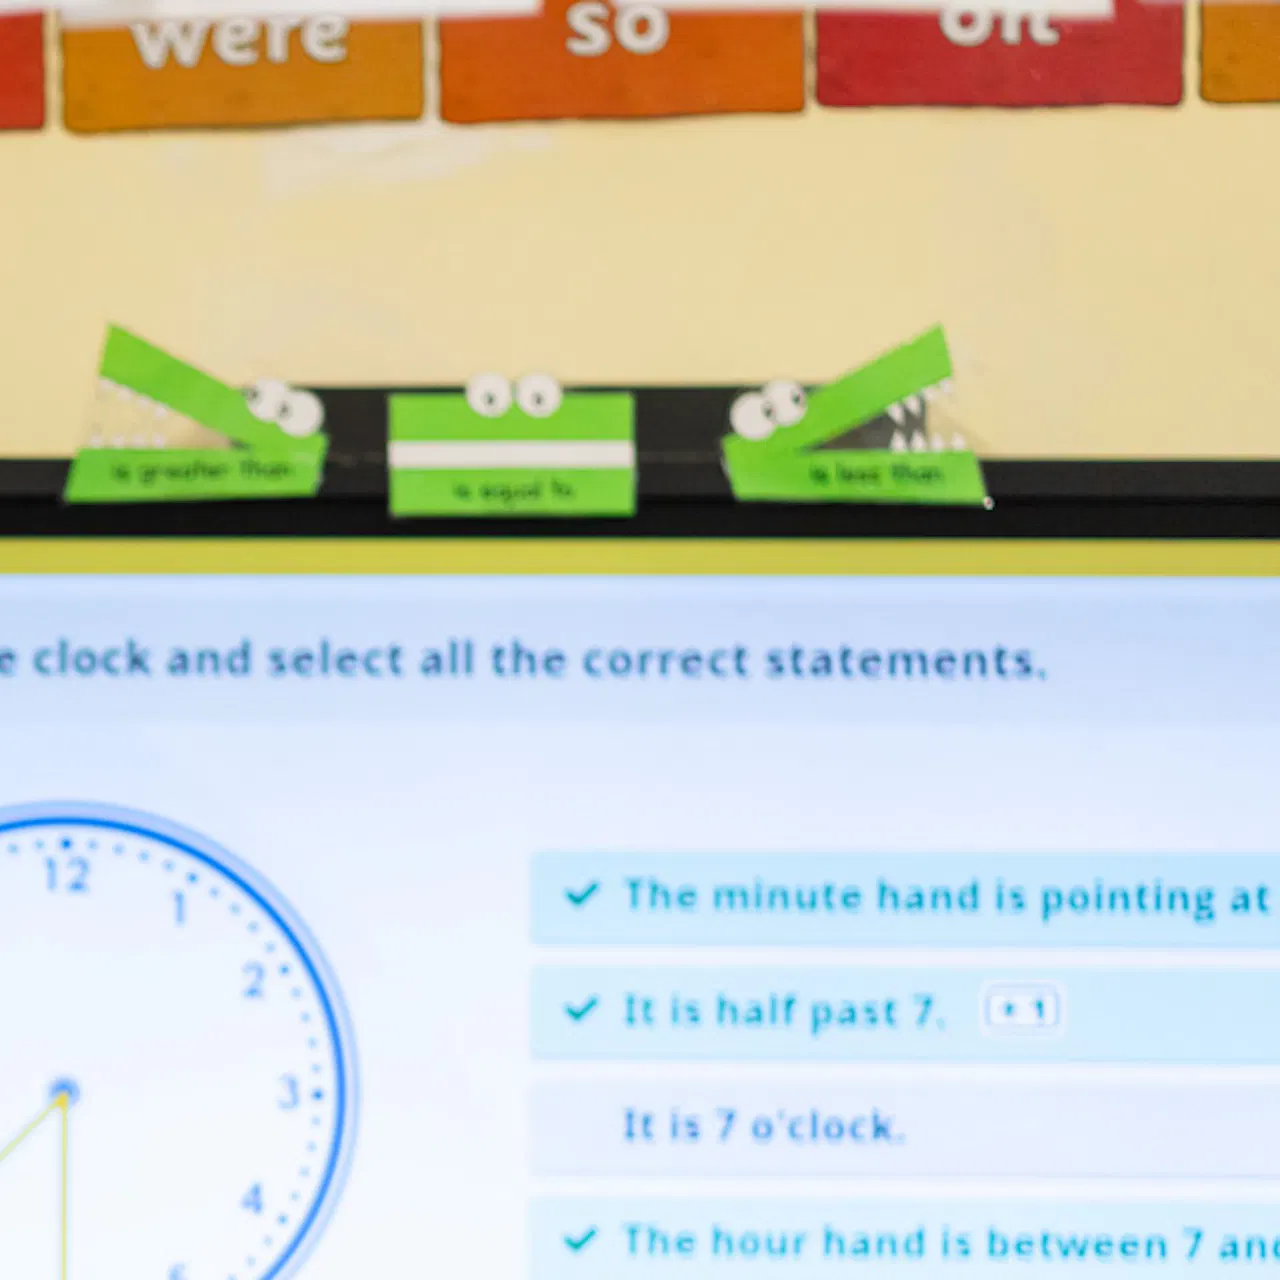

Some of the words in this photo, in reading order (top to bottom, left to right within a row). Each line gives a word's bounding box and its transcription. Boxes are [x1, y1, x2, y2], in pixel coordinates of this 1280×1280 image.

[130, 12, 350, 69] were
[564, 2, 670, 56] so
[32, 637, 151, 677] clock
[166, 638, 252, 677] and
[267, 639, 402, 677] select
[419, 639, 474, 677] all
[490, 639, 567, 677] the
[582, 645, 748, 678] correct
[766, 645, 1046, 679] statements.
[44, 855, 91, 894] 12
[172, 889, 186, 925] 1
[626, 877, 698, 910] The
[713, 883, 862, 912] minute
[877, 880, 980, 913] hand
[995, 883, 1027, 912] is
[1041, 883, 1216, 924] pointing
[1230, 885, 1269, 913] at
[242, 961, 267, 1000] 2
[625, 993, 655, 1027] It
[670, 996, 701, 1025] is
[716, 994, 797, 1025] half
[810, 999, 897, 1036] past
[913, 993, 946, 1033] 7.
[278, 1074, 301, 1111] 3
[624, 1107, 654, 1142] It
[669, 1112, 701, 1141] is
[717, 1107, 738, 1142] 7
[751, 1109, 907, 1145] o'clock.
[240, 1182, 265, 1216] 4
[626, 1223, 697, 1255] The
[711, 1225, 806, 1258] hour
[823, 1226, 926, 1258] hand
[941, 1229, 972, 1258] is
[987, 1229, 1168, 1260] between
[1184, 1227, 1204, 1260] 7
